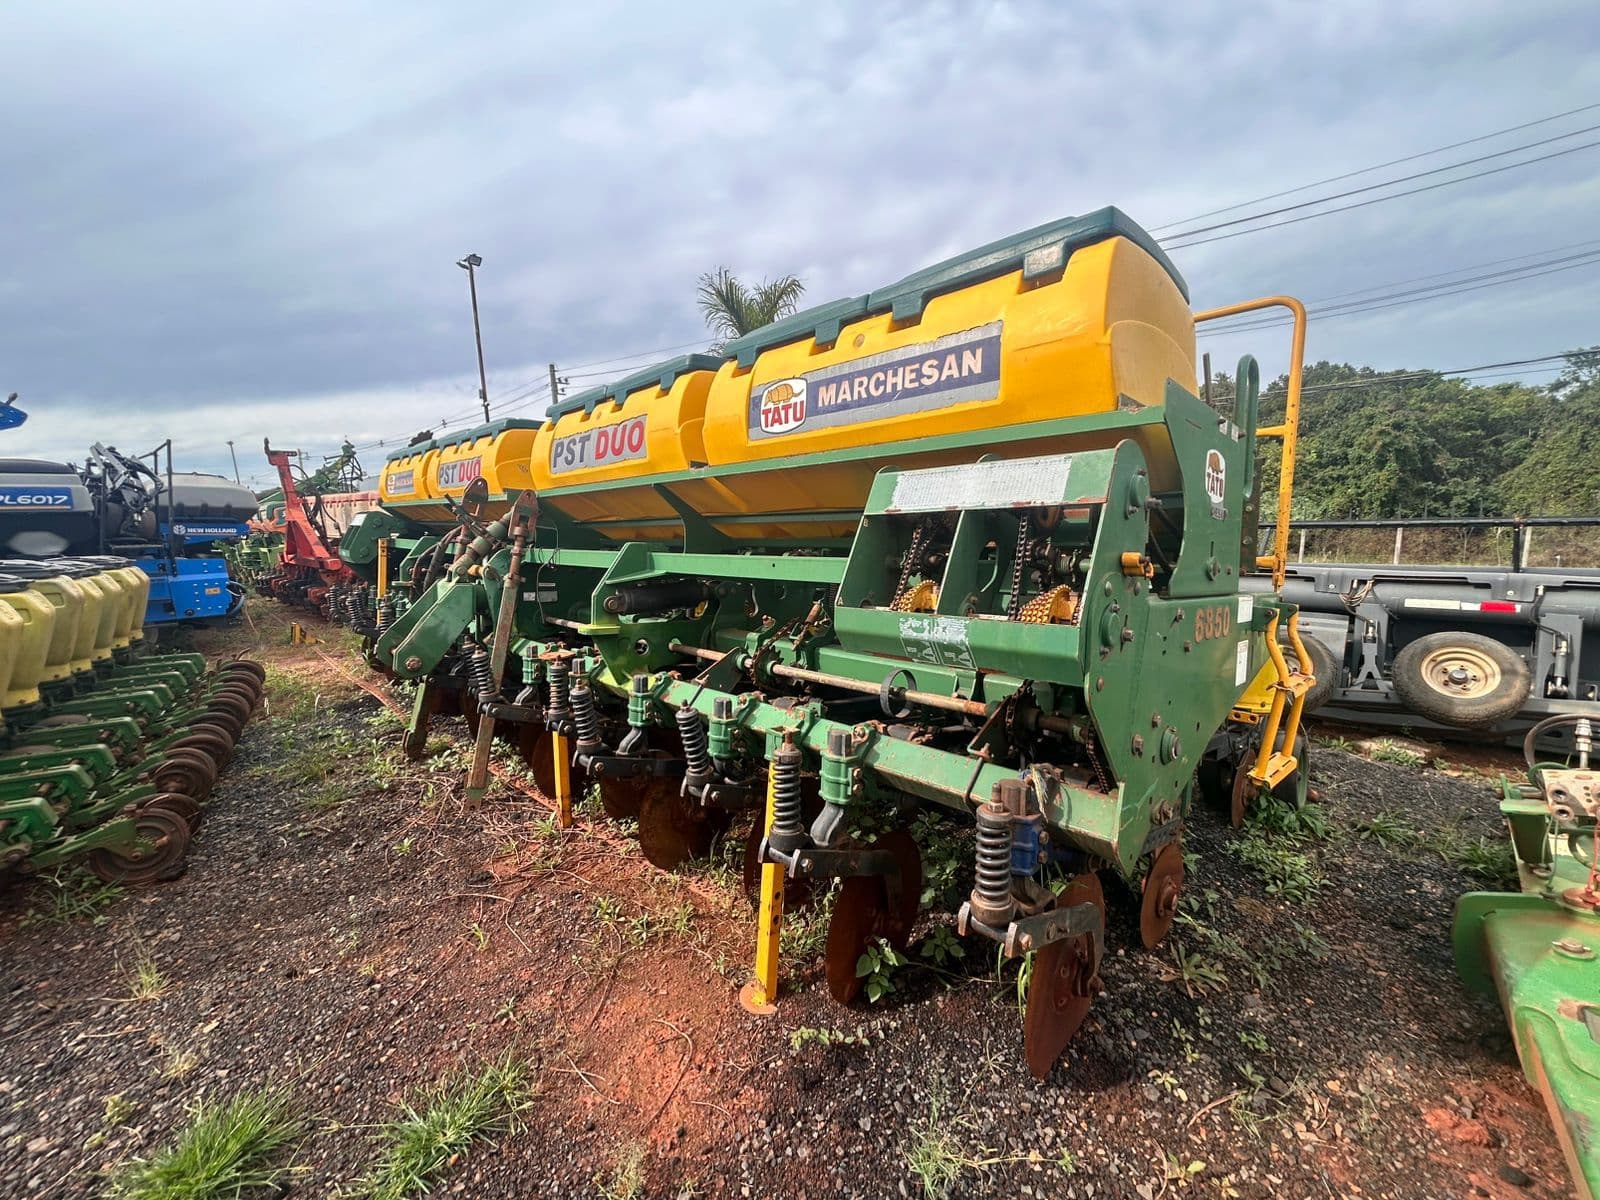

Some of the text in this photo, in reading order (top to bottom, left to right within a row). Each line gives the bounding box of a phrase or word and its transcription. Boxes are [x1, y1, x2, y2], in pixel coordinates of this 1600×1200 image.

[762, 348, 983, 428] TATU MARCHESAN
[553, 420, 645, 468] PST DUO
[439, 464, 457, 485] PST
[1207, 472, 1224, 498] TATU
[1195, 606, 1231, 644] 6850
